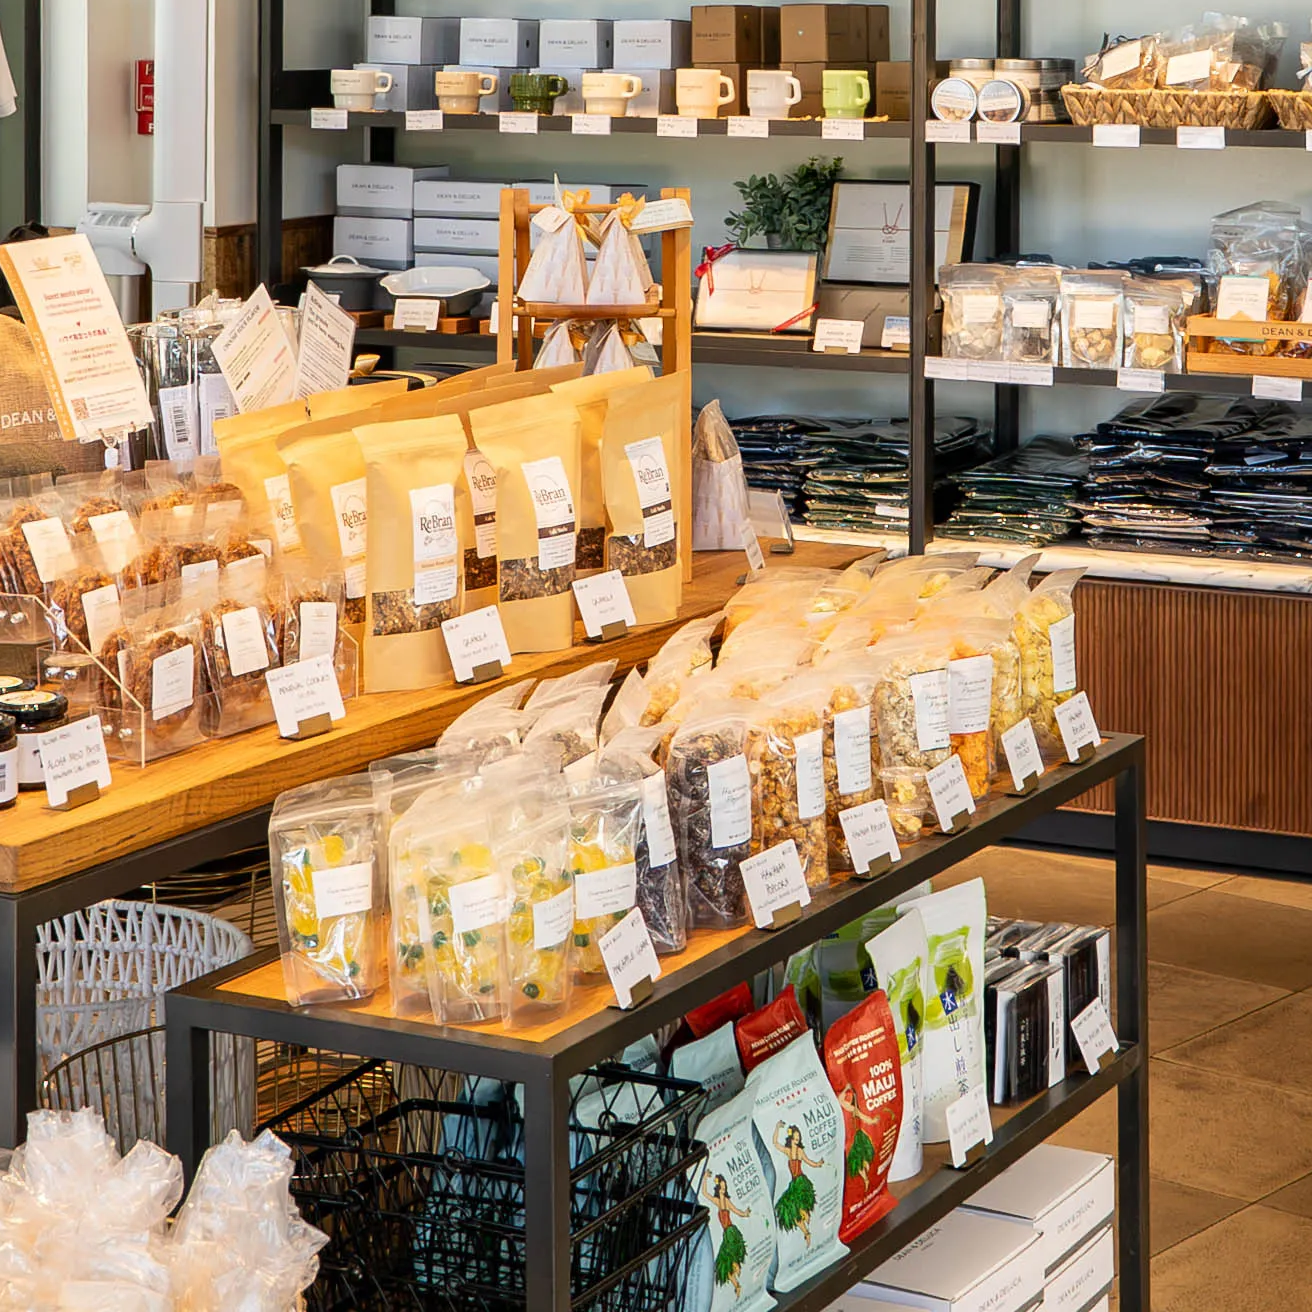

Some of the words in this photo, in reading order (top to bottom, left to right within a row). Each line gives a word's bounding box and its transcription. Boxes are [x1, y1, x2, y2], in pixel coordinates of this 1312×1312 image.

[1261, 327, 1295, 337] DEAN
[1297, 328, 1305, 337] &
[0, 408, 44, 430] DEAN
[46, 408, 58, 422] &
[471, 473, 497, 492] ReBra
[636, 465, 665, 484] ReBran
[341, 509, 368, 529] ReBra
[419, 512, 454, 533] ReBran
[868, 1058, 893, 1078] 100%
[790, 1069, 819, 1090] ROASTERS
[861, 1073, 897, 1100] MAUI
[812, 1092, 829, 1107] 10%
[865, 1088, 898, 1112] COFFEE
[801, 1101, 836, 1128] MAUI
[807, 1116, 838, 1138] COFFEE
[725, 1150, 753, 1176] MAUI
[732, 1166, 758, 1188] COFFEE
[736, 1175, 762, 1200] BLEND
